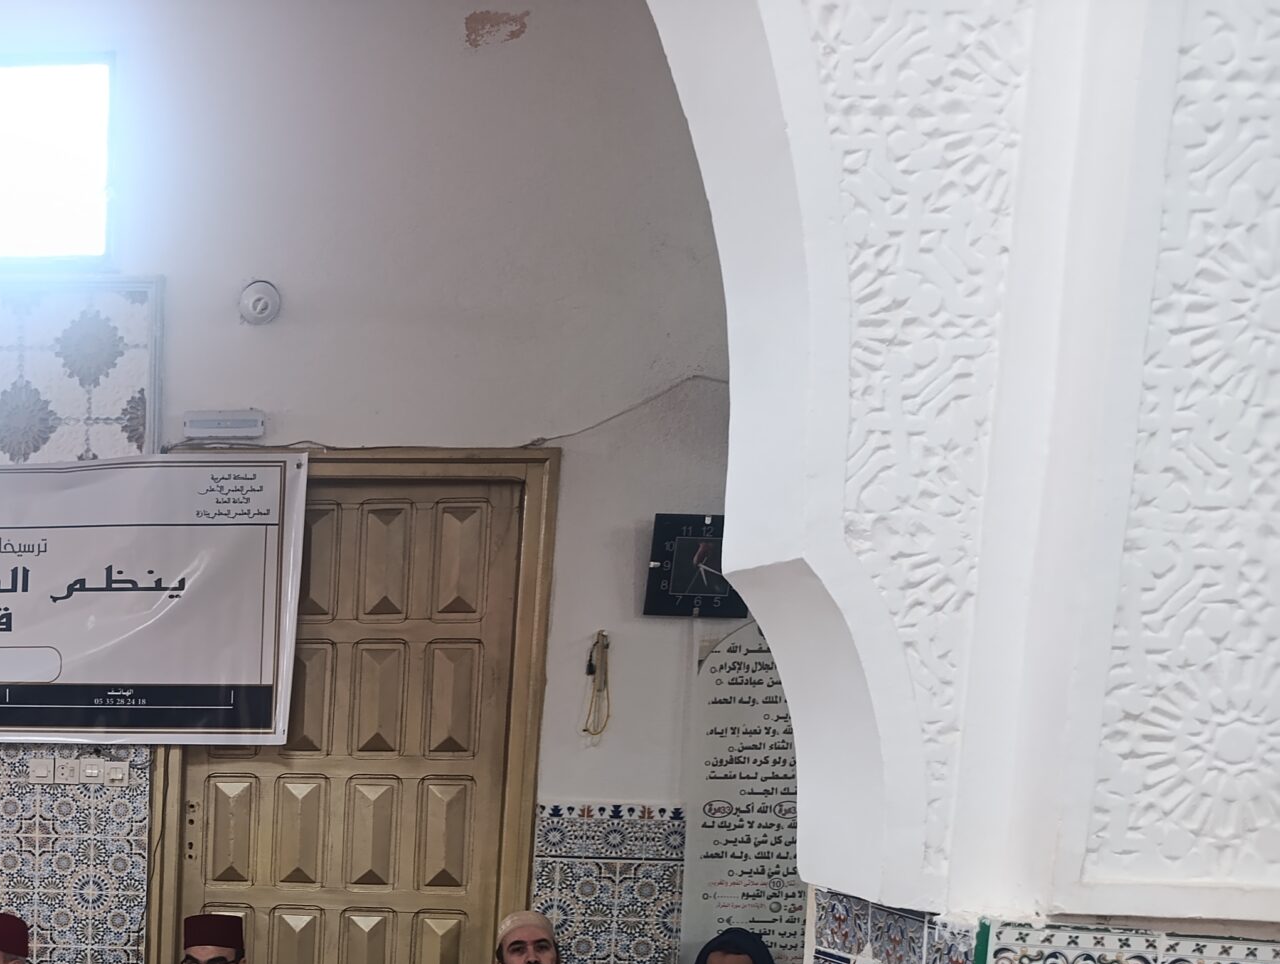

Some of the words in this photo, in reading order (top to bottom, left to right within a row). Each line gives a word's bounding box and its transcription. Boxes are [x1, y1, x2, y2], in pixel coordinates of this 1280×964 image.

[681, 526, 693, 537] 11
[701, 526, 714, 537] 12
[663, 540, 675, 552] 10
[662, 560, 671, 571] 9
[50, 564, 187, 604] ينظم
[660, 580, 669, 591] 8
[674, 596, 683, 607] 7
[693, 596, 703, 607] 6
[712, 597, 721, 608] 5
[726, 642, 742, 654] الله
[727, 676, 764, 688] عبادتك
[711, 755, 750, 767] الكافرون
[752, 755, 770, 767] كره
[772, 756, 787, 767] ولو
[756, 802, 773, 814] الله
